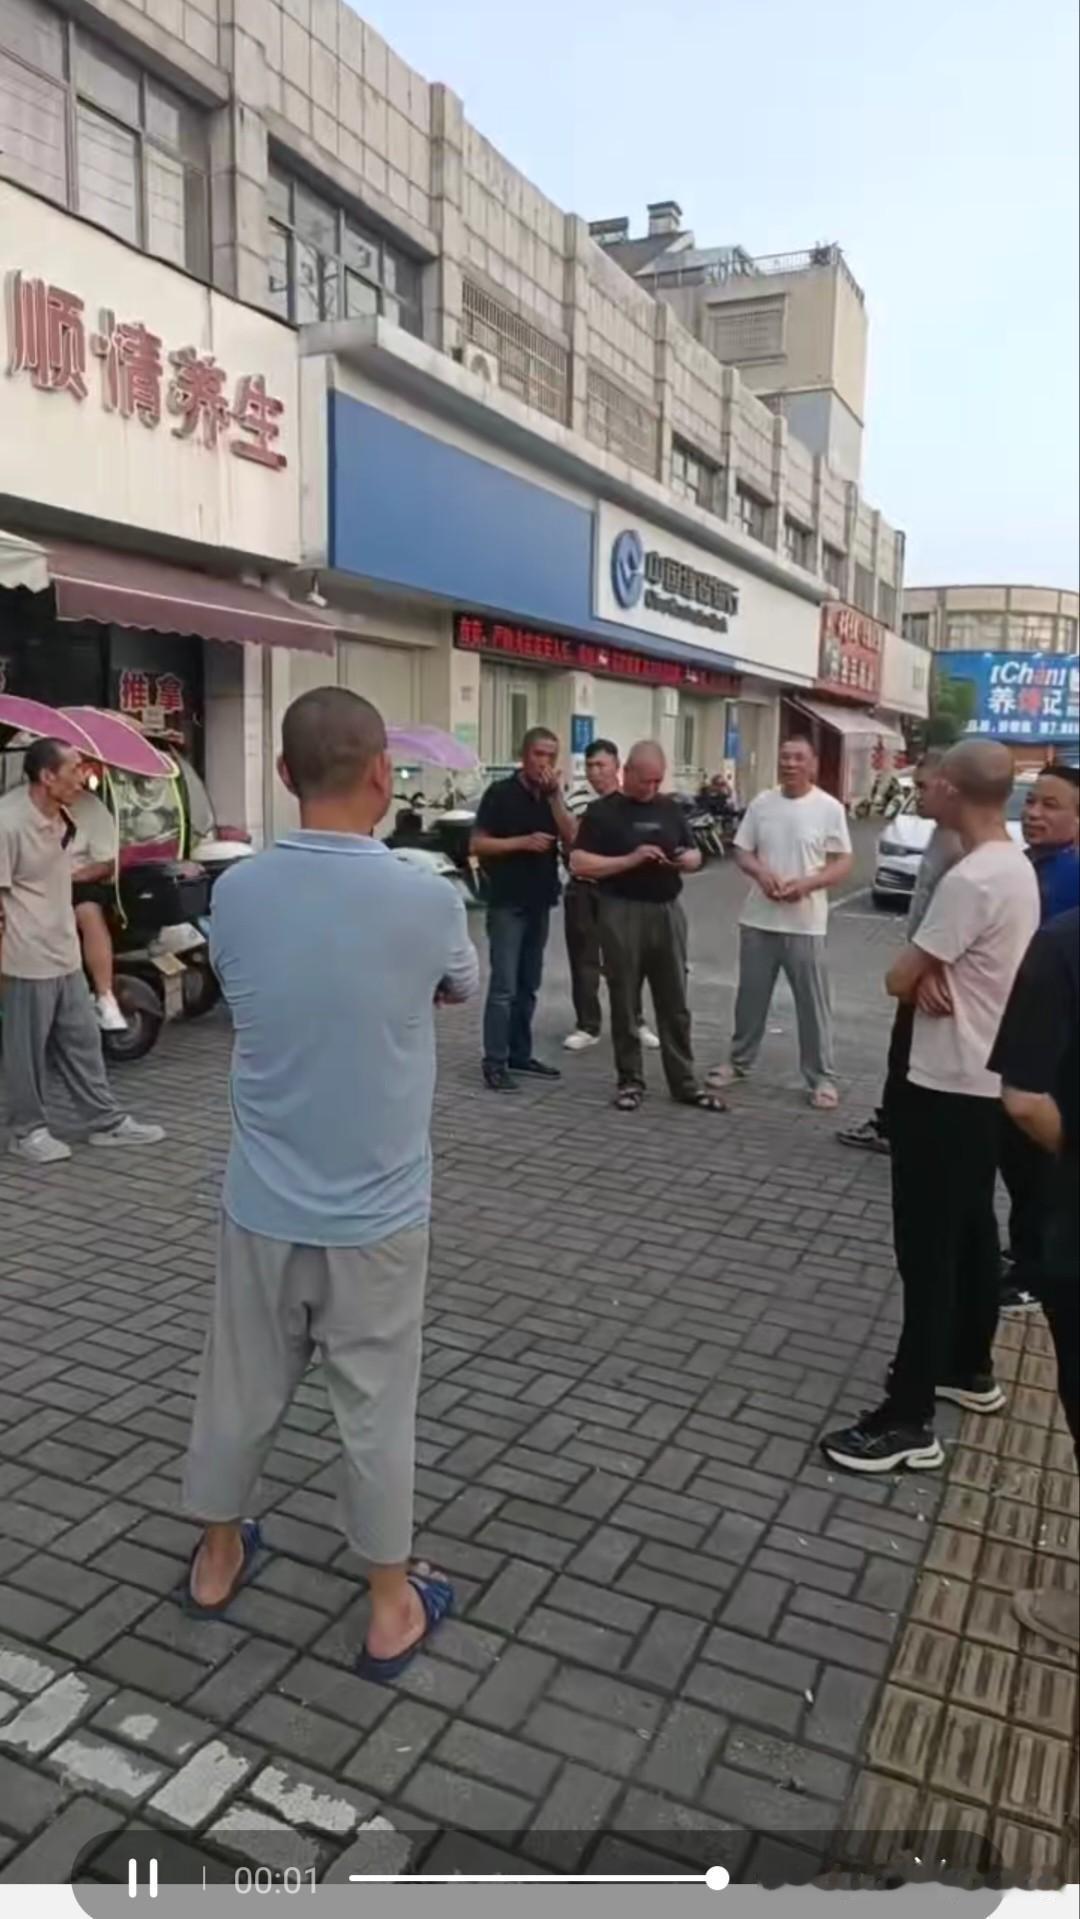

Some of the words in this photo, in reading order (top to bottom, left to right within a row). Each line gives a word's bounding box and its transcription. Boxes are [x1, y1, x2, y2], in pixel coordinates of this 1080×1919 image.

[4, 269, 288, 471] 顺情养生
[119, 668, 184, 712] 推拿
